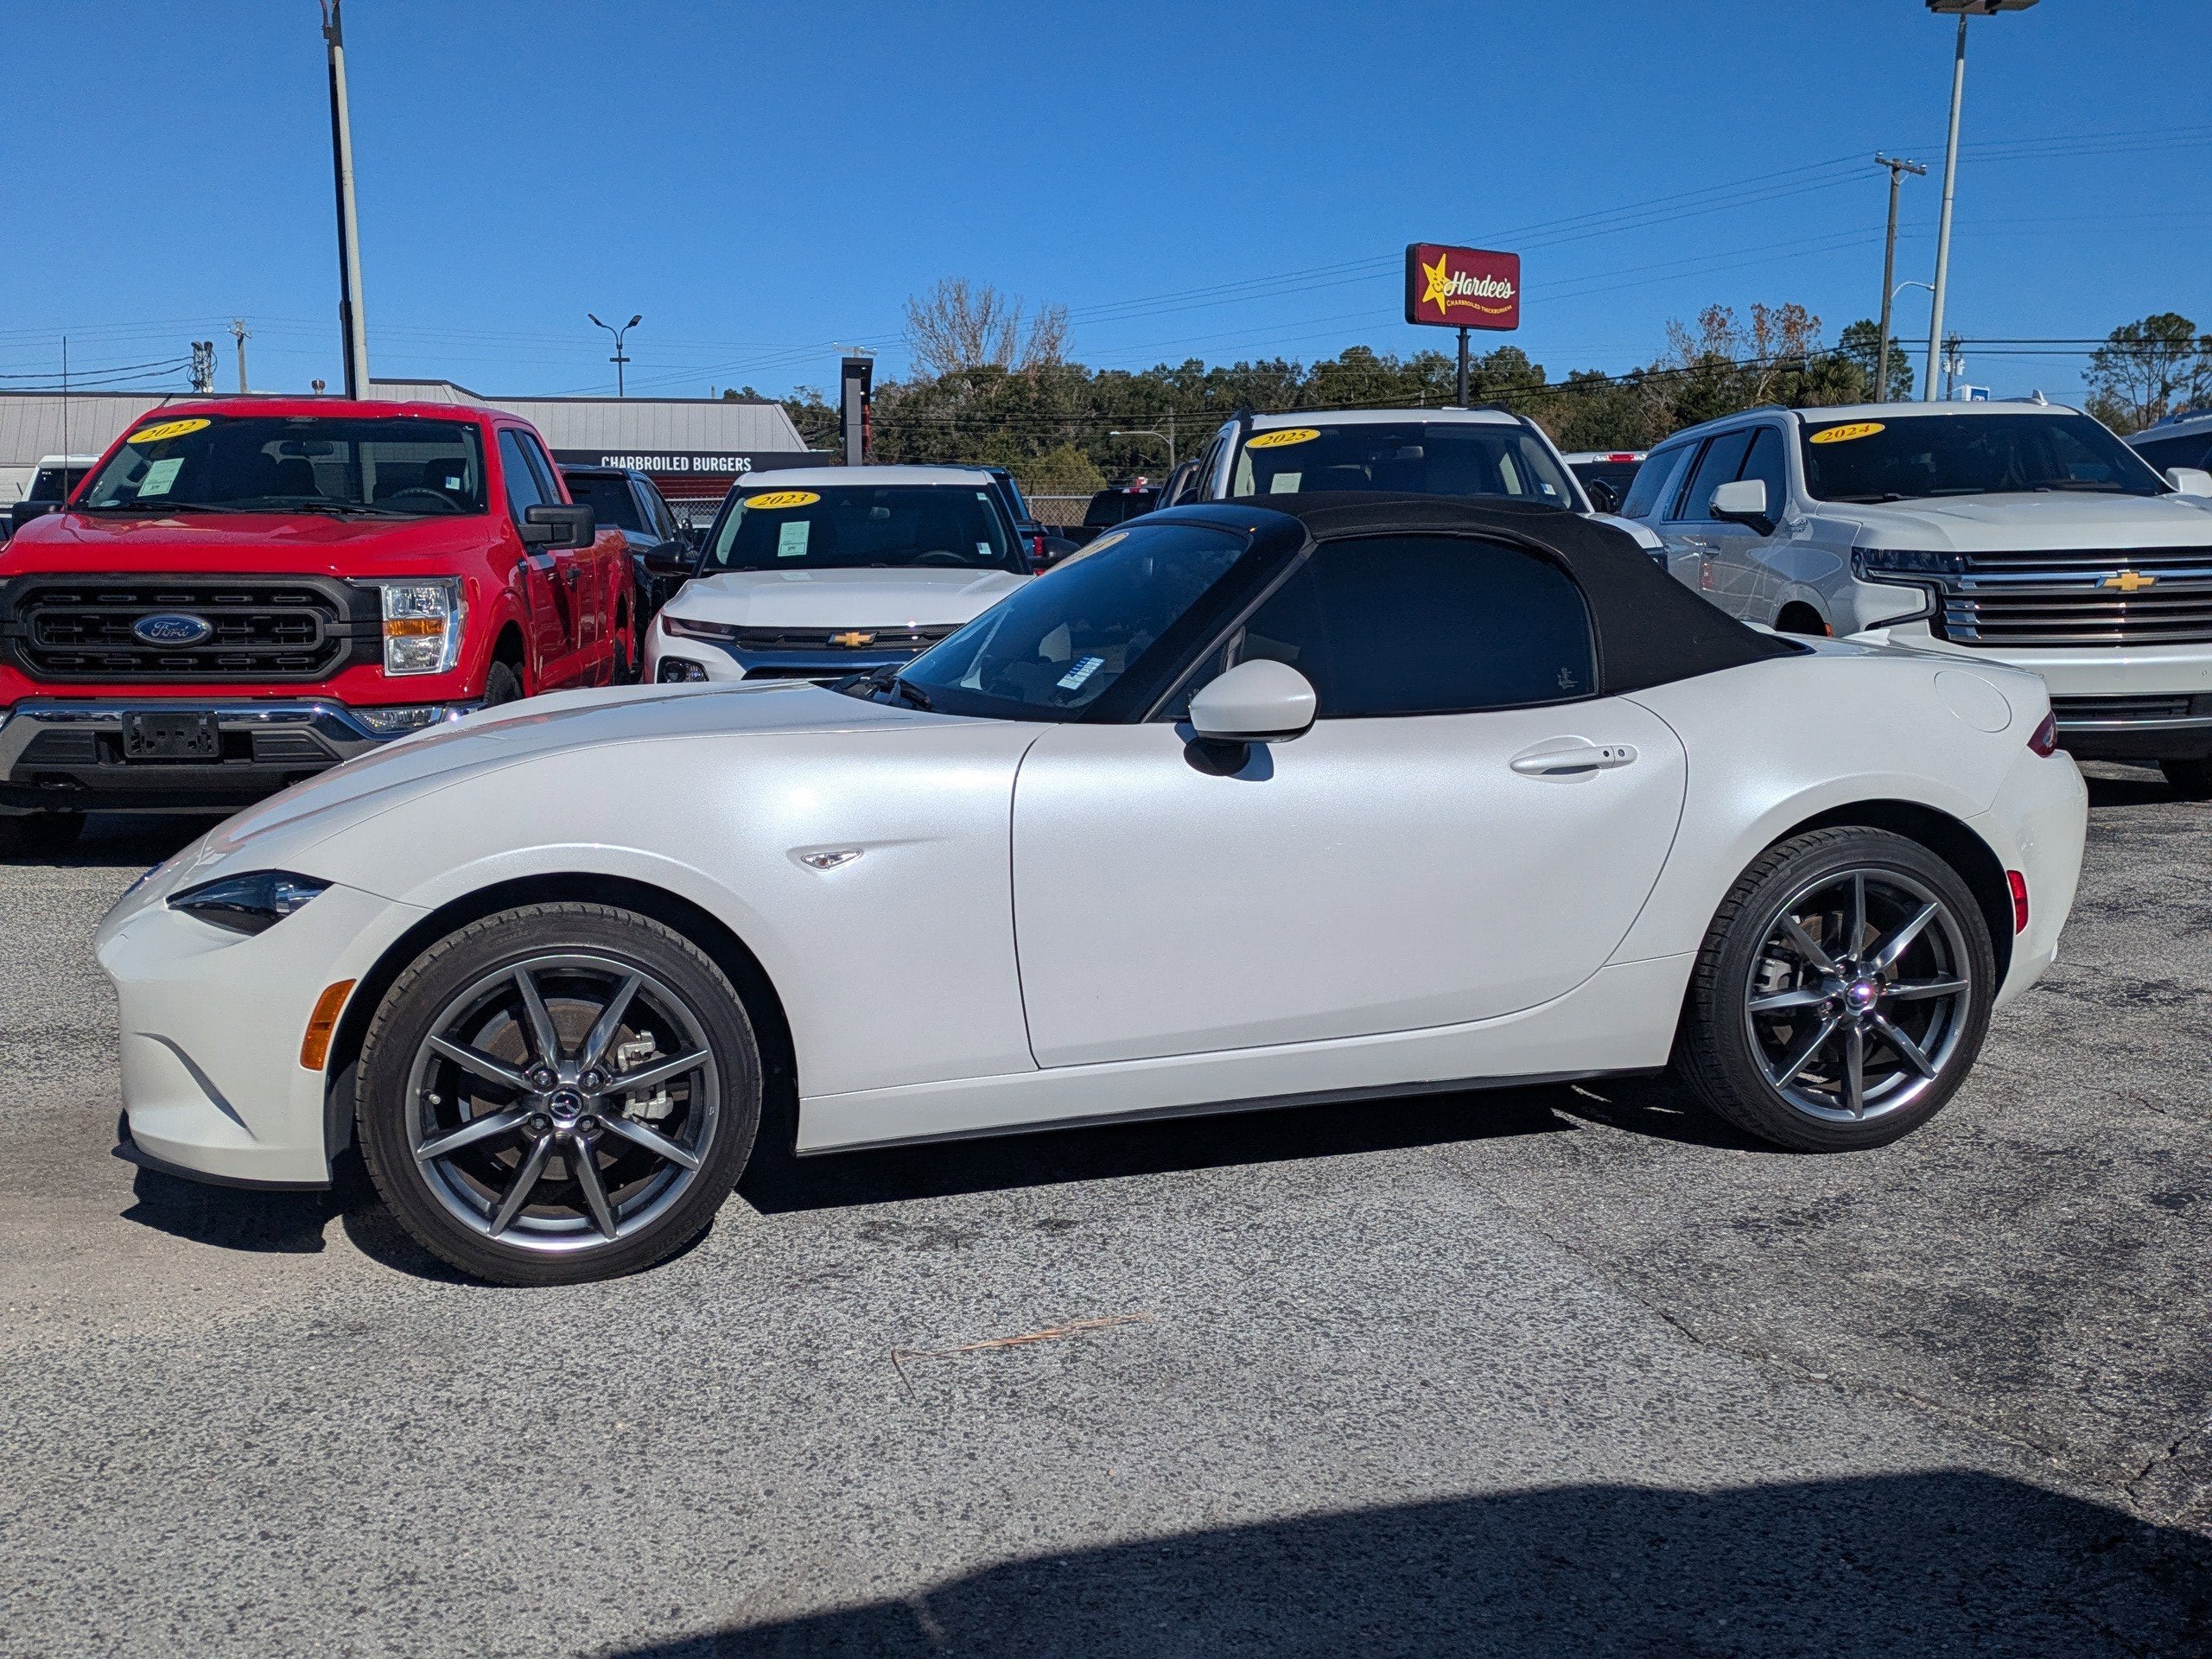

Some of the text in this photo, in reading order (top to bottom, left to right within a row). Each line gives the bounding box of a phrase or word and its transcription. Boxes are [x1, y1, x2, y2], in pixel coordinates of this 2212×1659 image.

[1443, 270, 1516, 299] Hardee's
[141, 422, 196, 441] 2022
[1261, 430, 1309, 446] 2025
[1823, 424, 1870, 442] 2024
[693, 457, 752, 472] BURGERS
[756, 493, 809, 506] 2023
[150, 620, 189, 637] Ford
